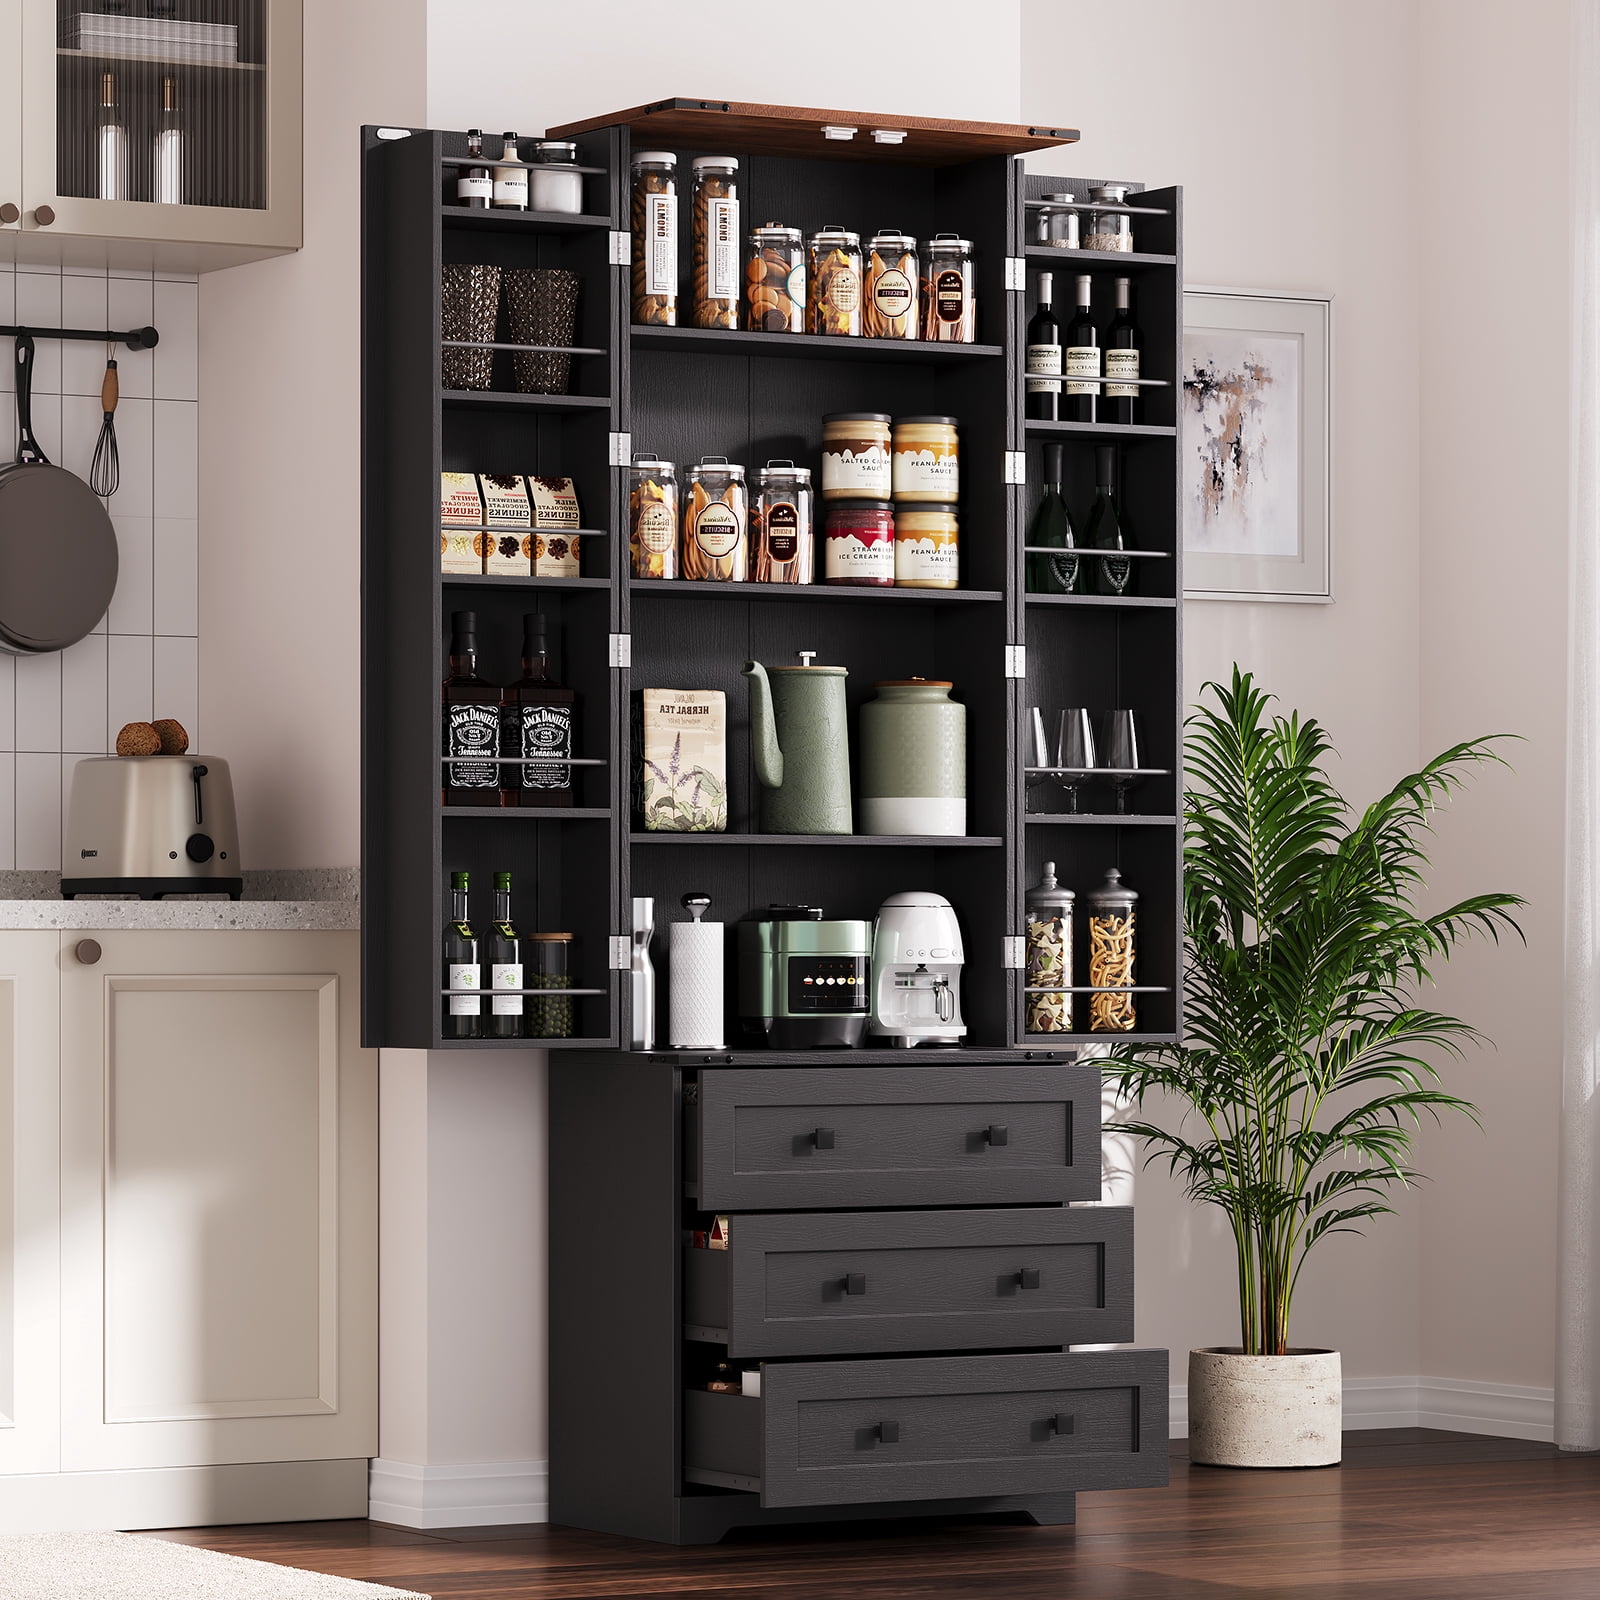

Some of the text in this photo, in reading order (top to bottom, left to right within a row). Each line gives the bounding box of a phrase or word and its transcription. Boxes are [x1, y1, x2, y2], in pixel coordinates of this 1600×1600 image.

[657, 202, 666, 237] ALMOND
[719, 207, 728, 241] ALMOND
[451, 708, 499, 728] JACK DANIEL'S
[523, 710, 571, 730] JACK DANIEL'S
[458, 746, 492, 756] Tennessee
[530, 747, 564, 757] Tennessee
